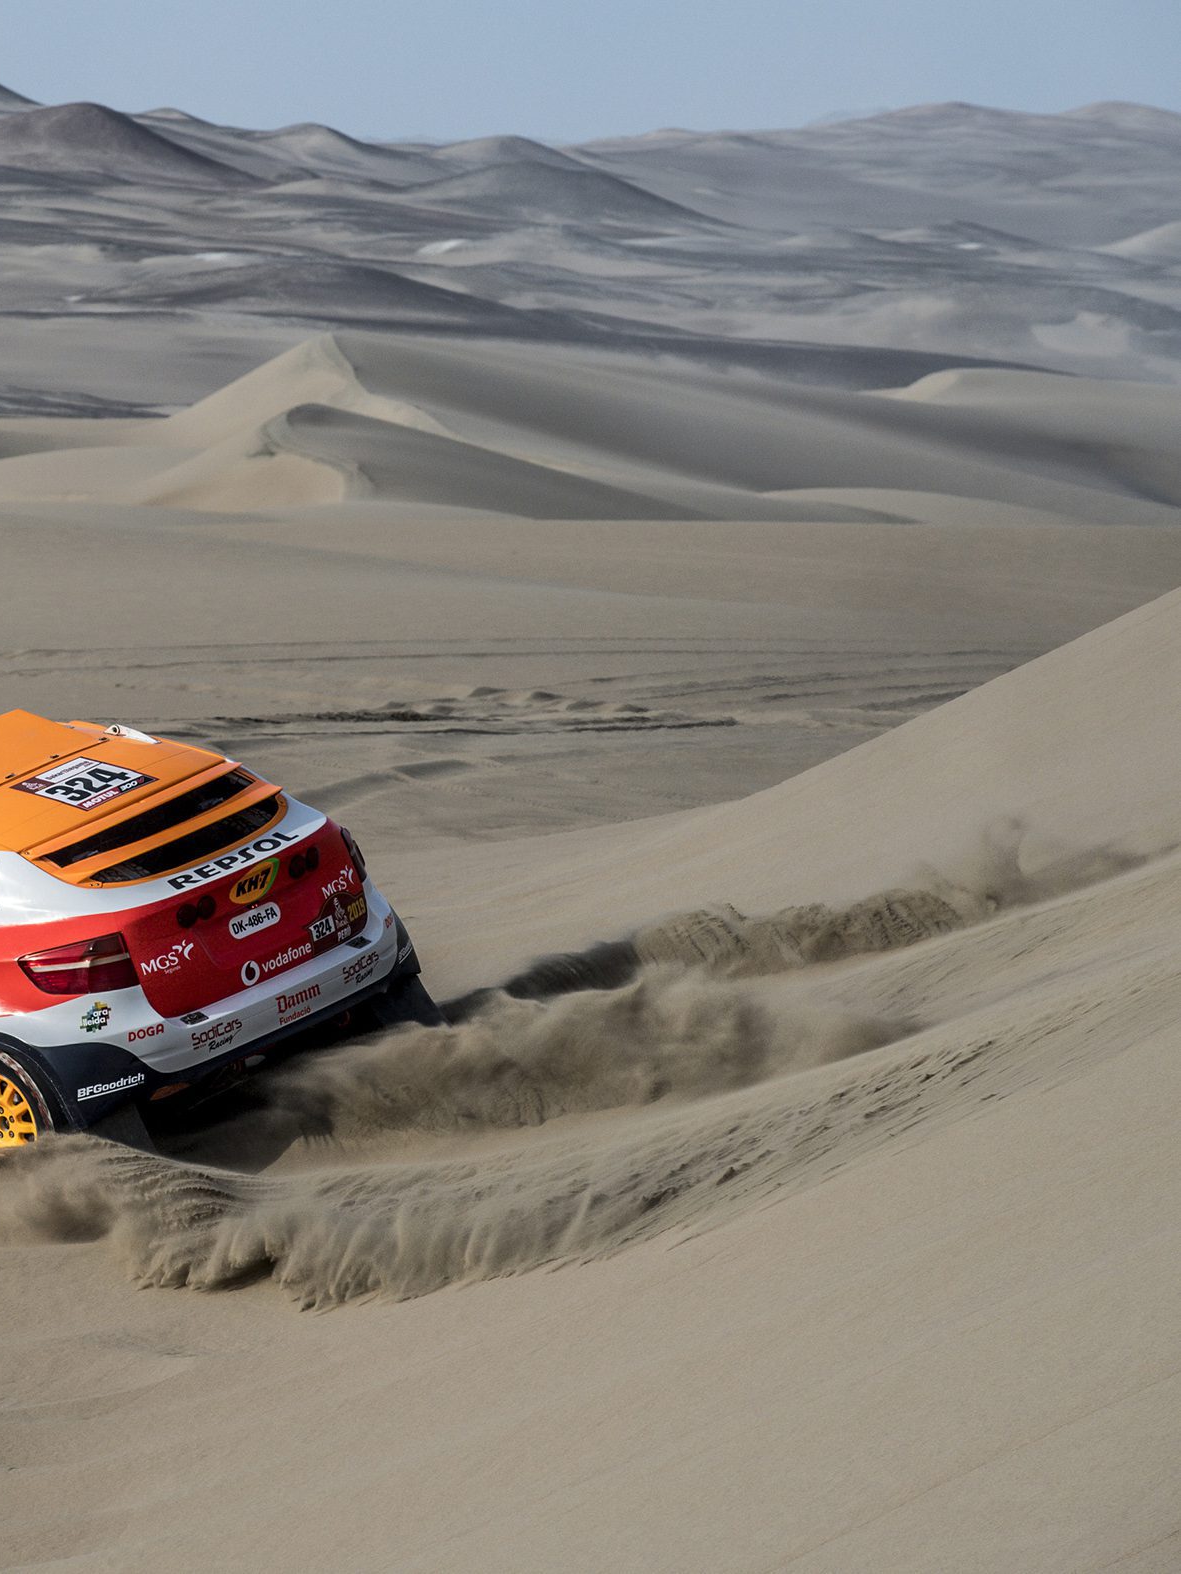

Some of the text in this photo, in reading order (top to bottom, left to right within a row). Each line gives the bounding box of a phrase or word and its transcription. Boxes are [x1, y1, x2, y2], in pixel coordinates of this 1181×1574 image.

[45, 768, 131, 801] 324
[82, 788, 119, 808] MOTUL
[167, 832, 299, 890] REPSOL
[321, 876, 347, 899] MGS
[231, 907, 278, 935] DK-486-FA
[347, 897, 366, 922] 2019
[313, 918, 332, 939] 324
[140, 951, 179, 976] MGS
[262, 942, 312, 973] vodafone
[275, 984, 321, 1014] Damm
[279, 1006, 311, 1026] Fundació
[128, 1023, 164, 1042] DOGA
[77, 1073, 144, 1098] BFGoodrich
